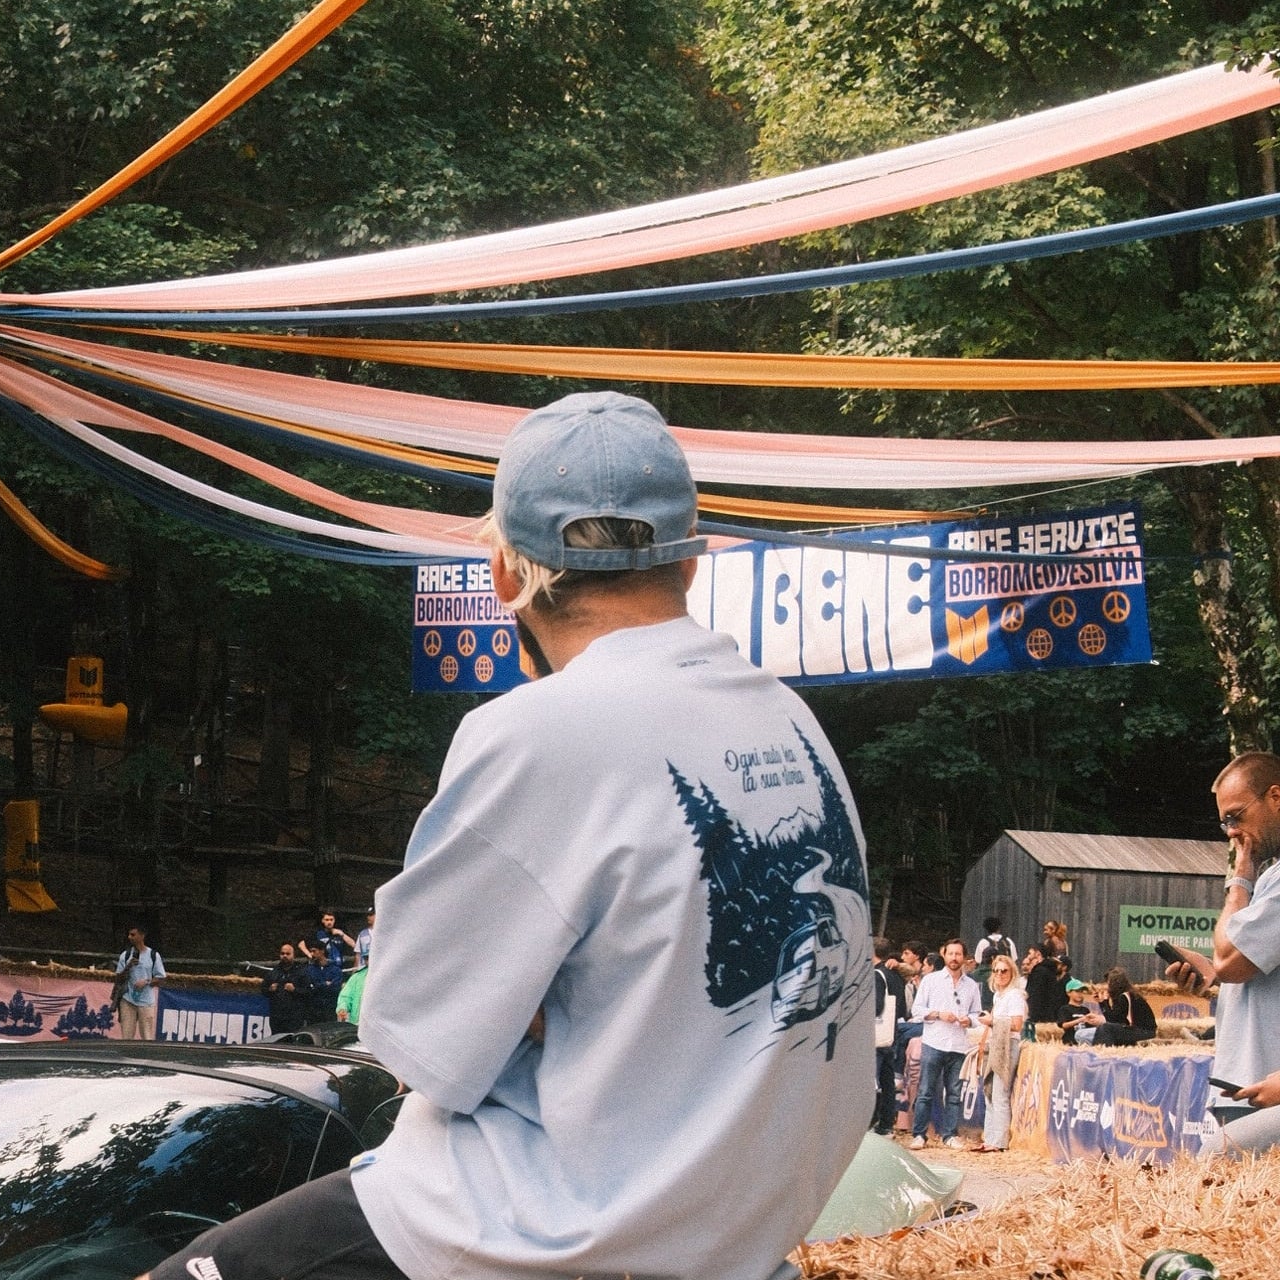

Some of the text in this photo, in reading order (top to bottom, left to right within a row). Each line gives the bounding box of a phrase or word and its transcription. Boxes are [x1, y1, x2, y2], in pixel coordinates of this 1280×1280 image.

[1018, 512, 1137, 555] SERVICE
[417, 565, 463, 592] RACE
[761, 536, 933, 677] BENE
[725, 748, 761, 776] Ogni
[742, 770, 757, 793] la
[761, 772, 781, 789] sua
